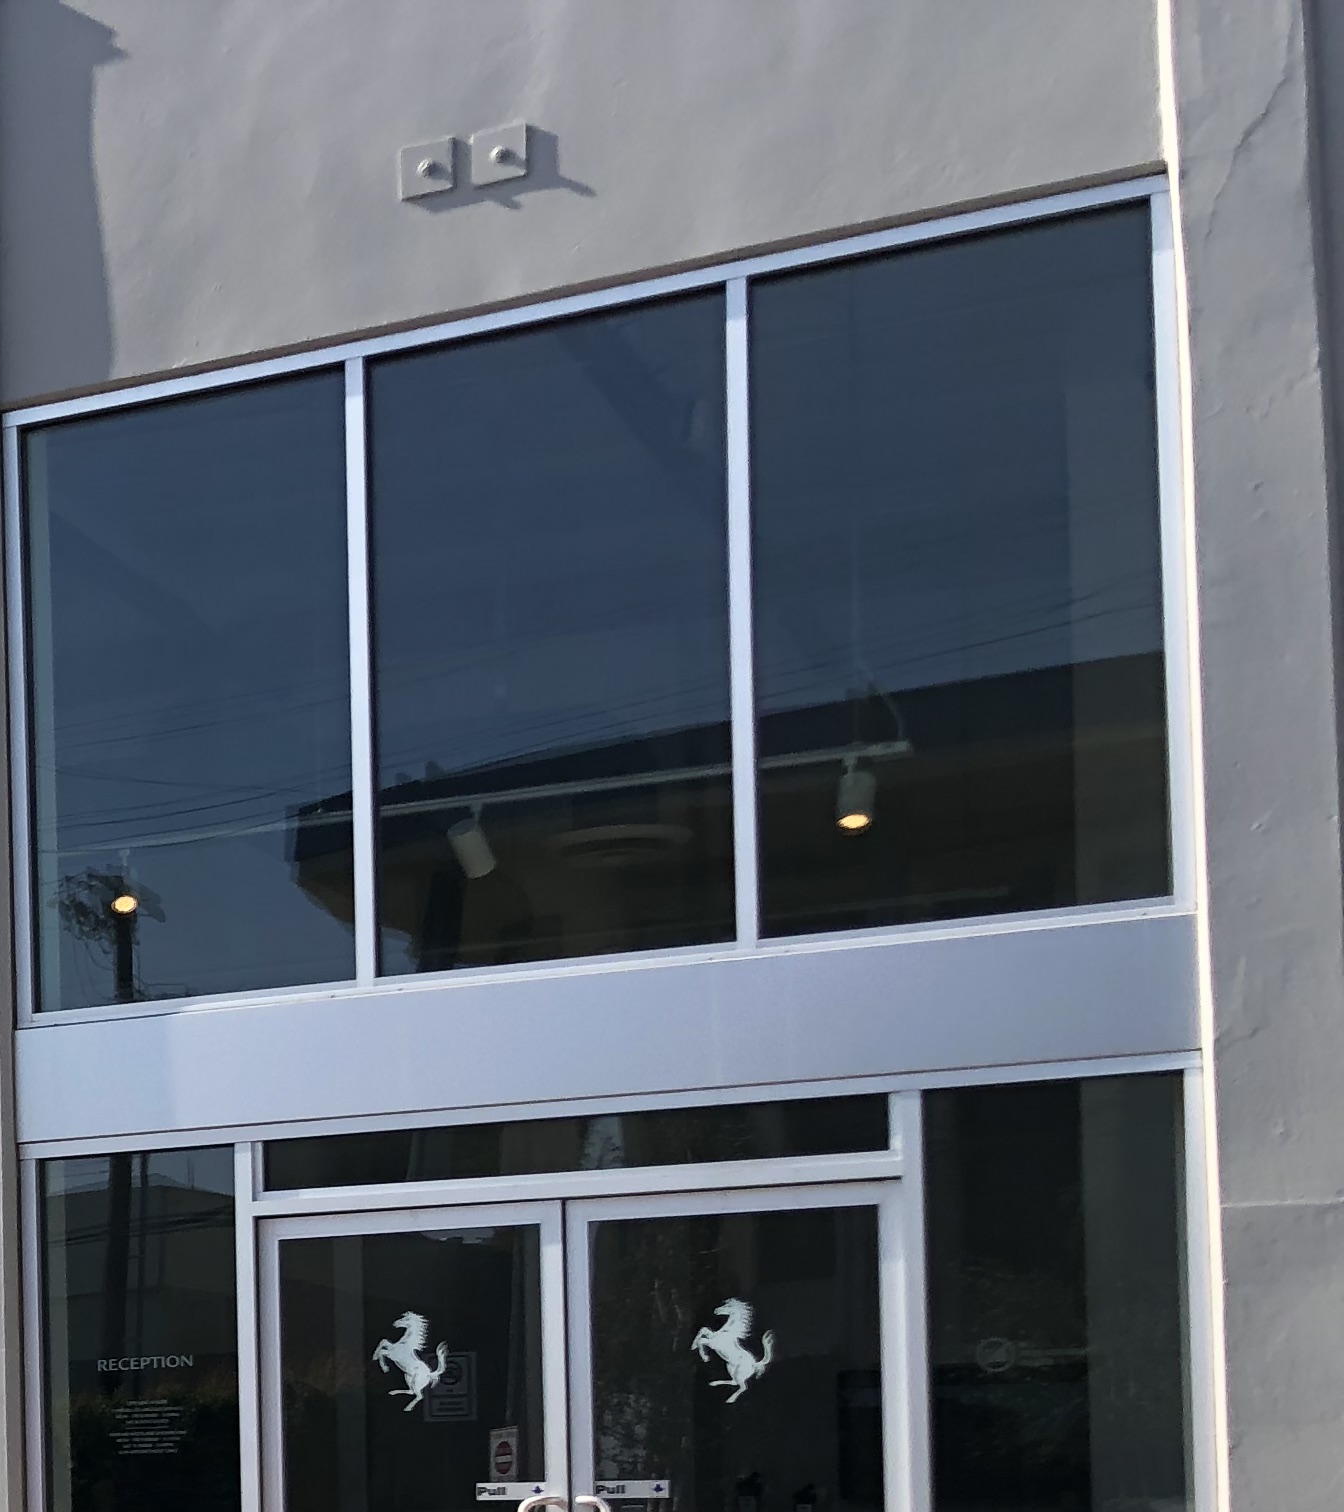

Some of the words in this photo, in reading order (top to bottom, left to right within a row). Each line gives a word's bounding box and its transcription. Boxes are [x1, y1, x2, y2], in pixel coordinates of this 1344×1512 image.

[97, 1354, 194, 1372] RECEPTION
[476, 1486, 507, 1496] Pull
[595, 1484, 626, 1494] Pull
